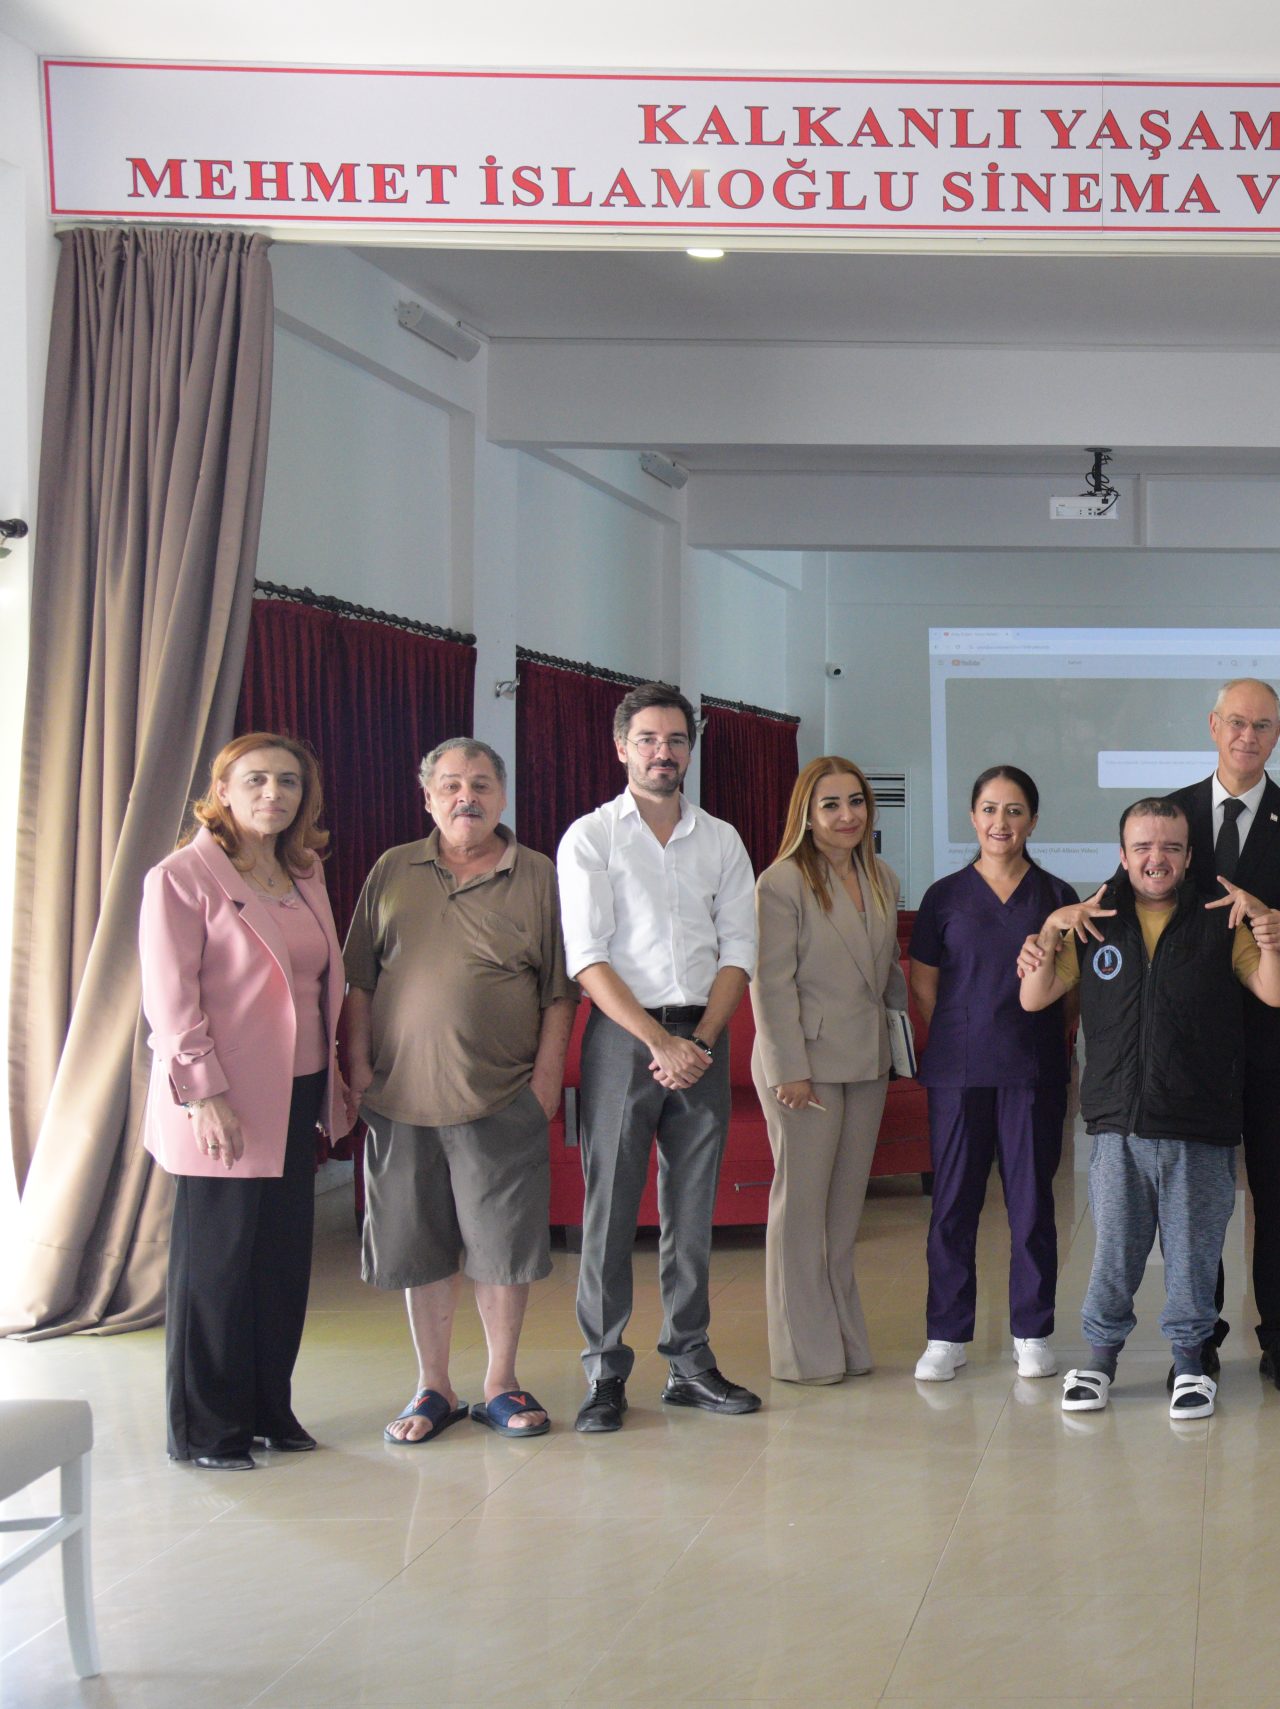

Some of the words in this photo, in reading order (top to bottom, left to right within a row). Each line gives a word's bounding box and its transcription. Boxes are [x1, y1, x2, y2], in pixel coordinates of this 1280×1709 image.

[638, 104, 1022, 149] KALKANLI
[126, 157, 457, 205] MEHMET
[482, 154, 919, 212] İSLAMOĞLU
[942, 162, 1221, 214] SİNEMA
